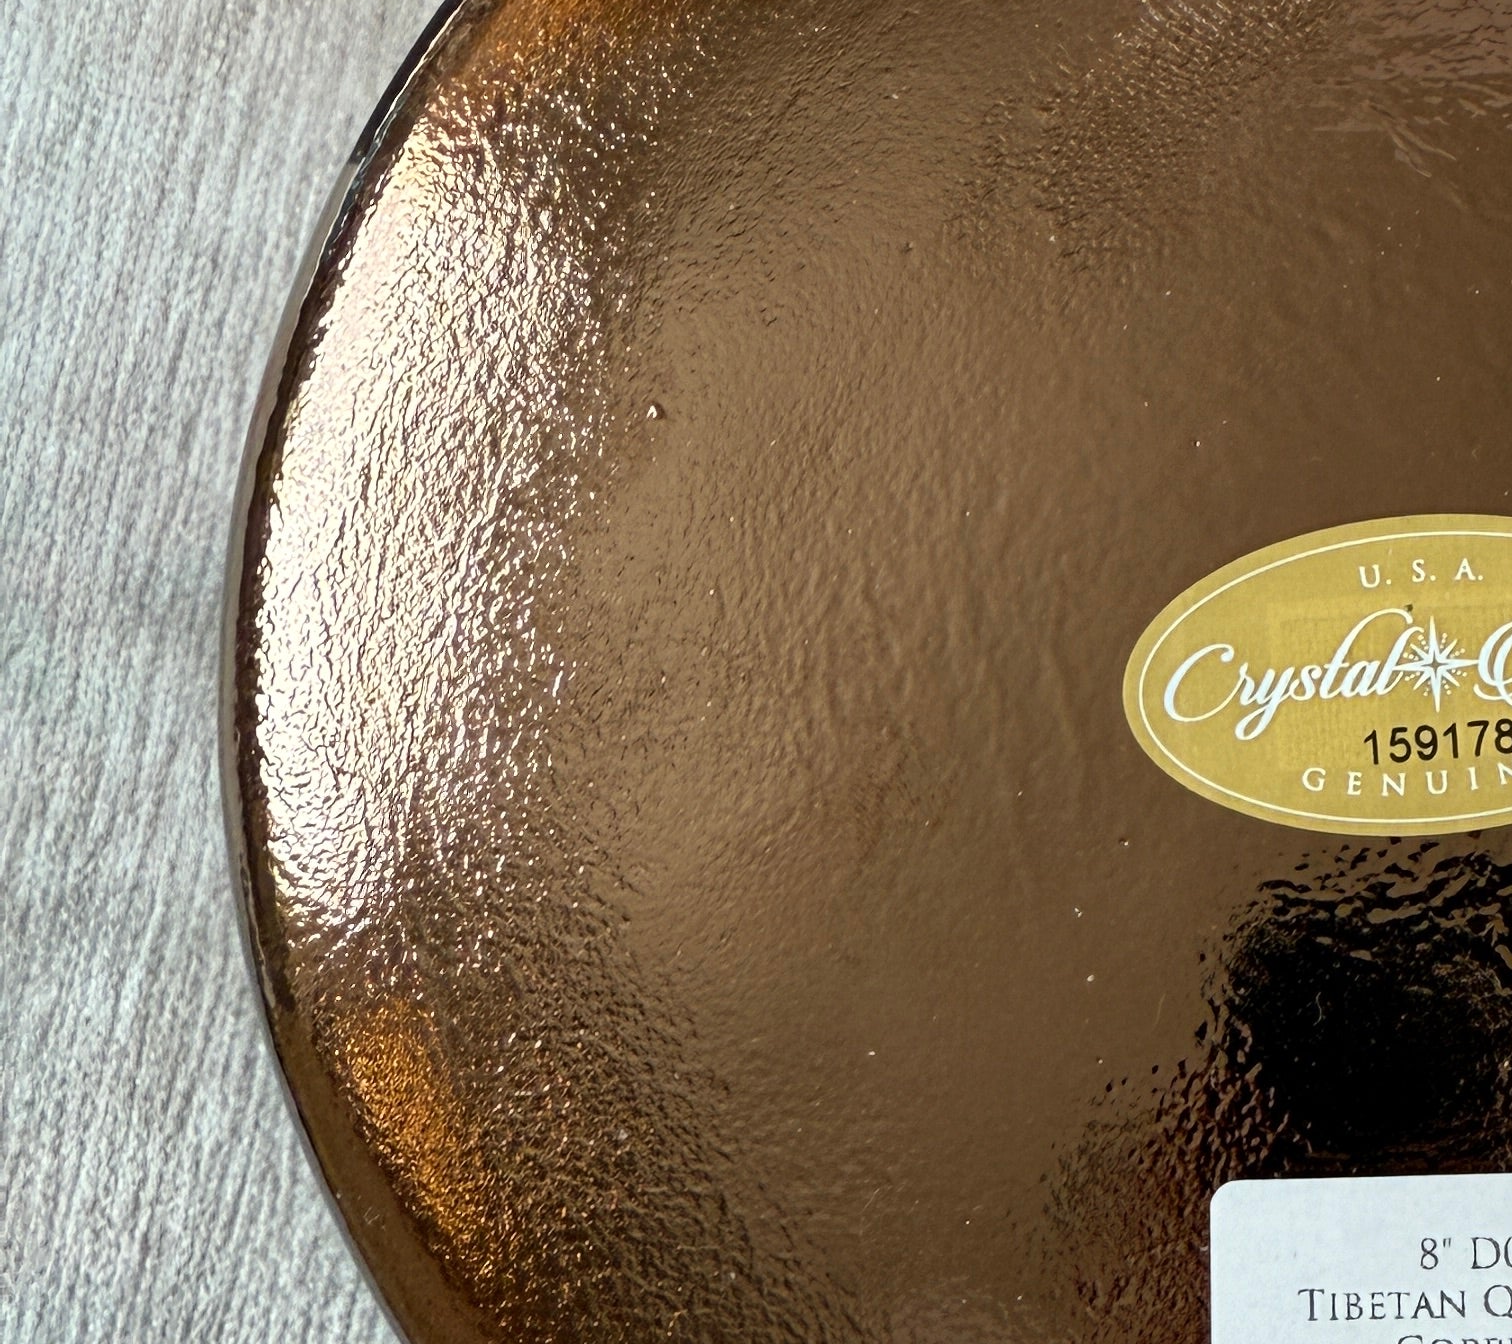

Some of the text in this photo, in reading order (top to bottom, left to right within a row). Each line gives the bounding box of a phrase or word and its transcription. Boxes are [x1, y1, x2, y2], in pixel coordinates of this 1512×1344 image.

[1163, 607, 1425, 742] Crystal
[1418, 1235, 1454, 1271] 8"
[1296, 1286, 1467, 1323] TIBETAN
